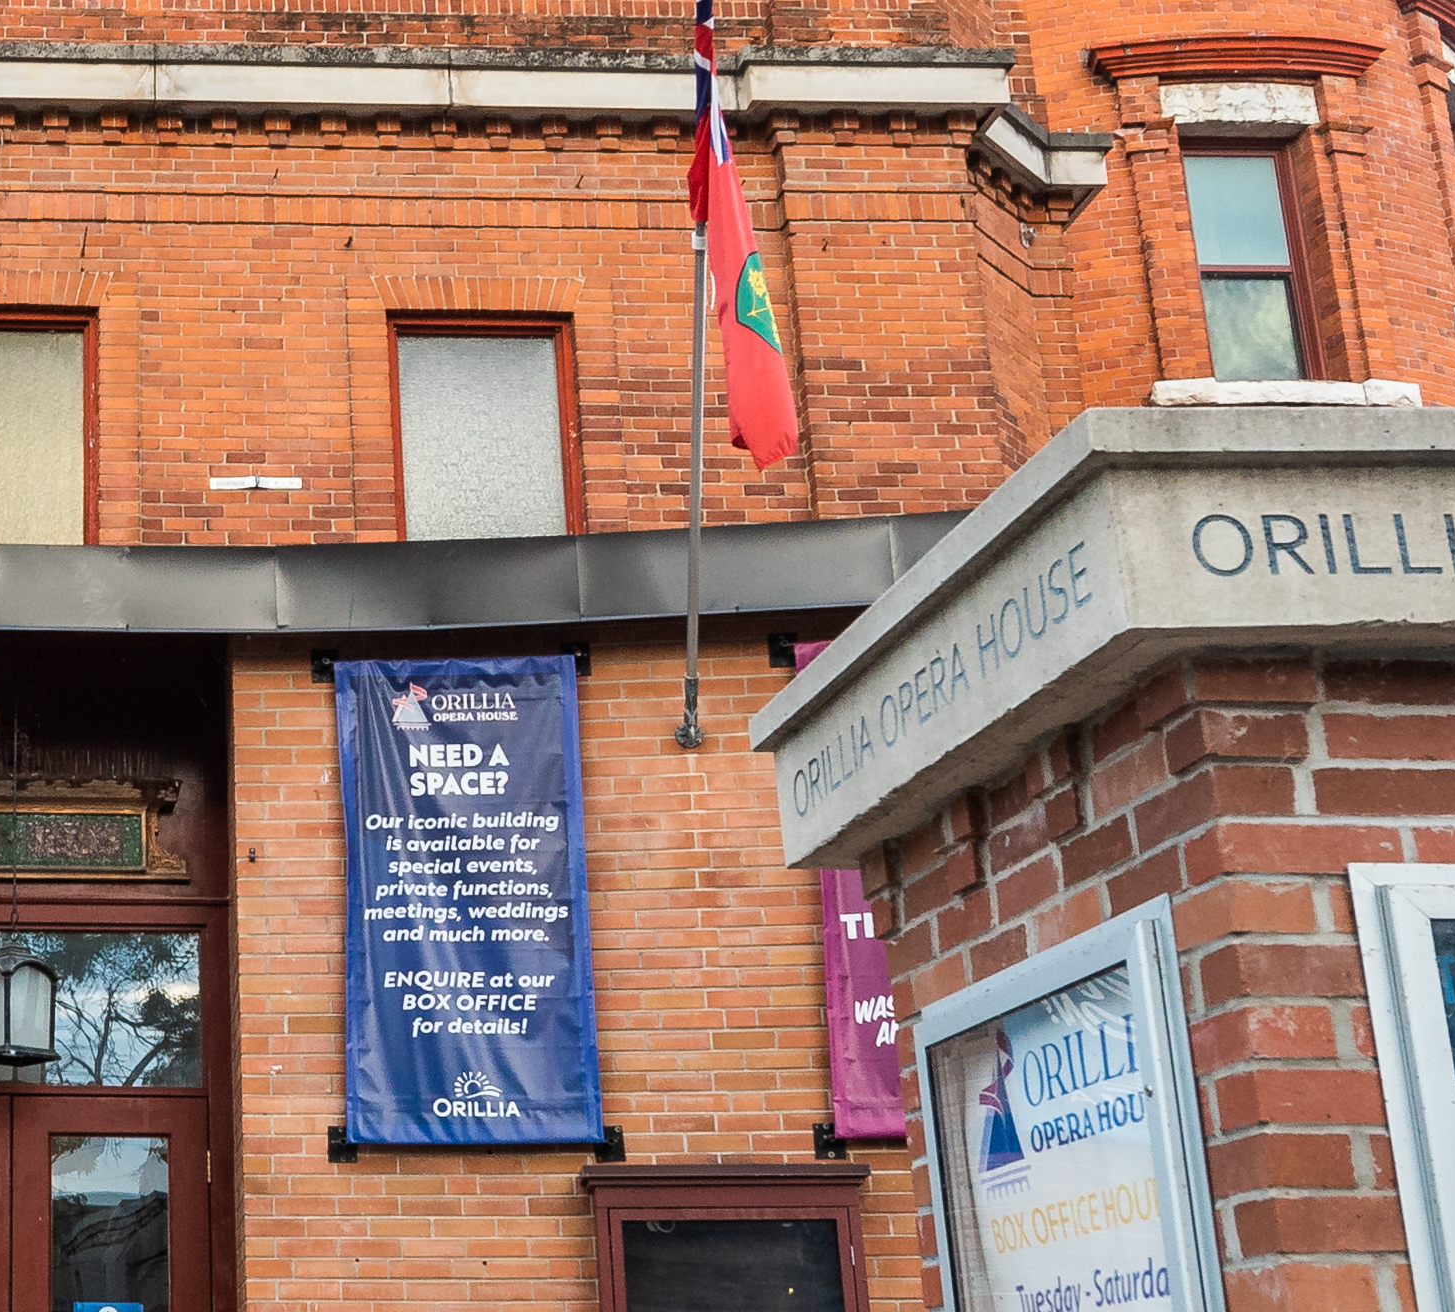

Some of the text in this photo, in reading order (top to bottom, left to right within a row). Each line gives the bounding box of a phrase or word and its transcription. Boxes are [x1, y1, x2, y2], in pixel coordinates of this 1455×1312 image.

[793, 541, 1092, 817] ORILLIA OPERA HOUSE
[431, 693, 515, 710] ORILLIA
[433, 710, 518, 722] OPERA HOUSE
[409, 744, 510, 768] NEED A
[410, 771, 508, 795] SPACE?
[365, 813, 559, 833] Our iconic building
[385, 834, 539, 854] is available for
[388, 857, 538, 877] special events,
[375, 879, 553, 901] private functions,
[364, 902, 569, 923] meetings, weddings
[383, 925, 549, 942] and much more.
[383, 971, 554, 991] ENQUIRE at our
[402, 993, 537, 1012] BOX OFFICE
[412, 1016, 527, 1038] for details!
[432, 1098, 520, 1118] ORILLIA
